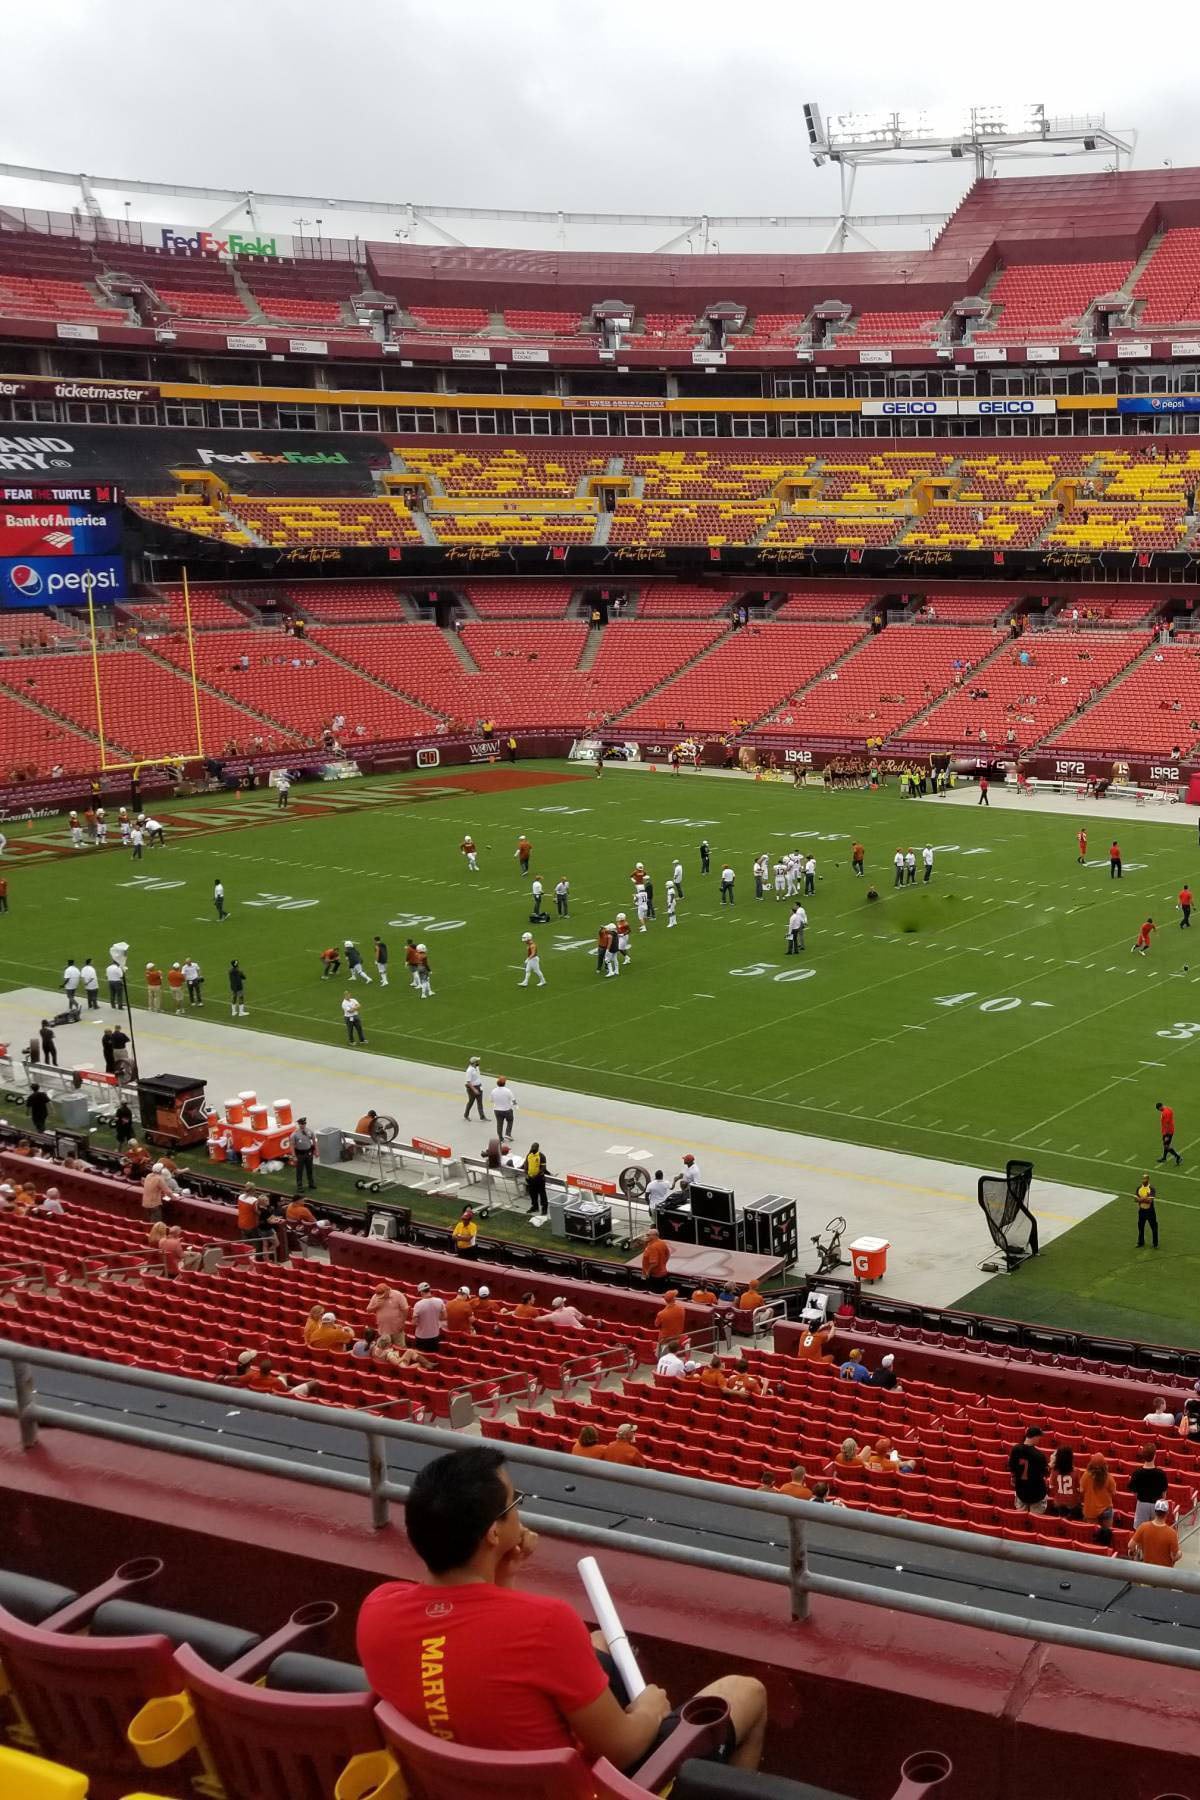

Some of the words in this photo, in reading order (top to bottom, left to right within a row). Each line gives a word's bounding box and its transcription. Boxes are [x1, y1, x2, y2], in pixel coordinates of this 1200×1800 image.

[161, 229, 276, 256] FedExField
[882, 402, 937, 414] GEICO
[978, 401, 1034, 413] GEICO
[1162, 399, 1185, 409] pepsi
[197, 449, 349, 466] FedExField
[5, 514, 39, 527] Bank
[40, 513, 53, 527] of
[56, 513, 107, 527] America
[47, 568, 117, 595] pepsi
[420, 750, 437, 764] 40
[785, 750, 812, 763] 1942
[1056, 761, 1085, 774] 1972
[1150, 766, 1179, 780] 1982
[388, 913, 468, 932] 30
[729, 962, 817, 983] 50
[932, 991, 1022, 1013] 40
[855, 1256, 869, 1272] G
[803, 1335, 814, 1348] 8
[1057, 1474, 1074, 1495] 12
